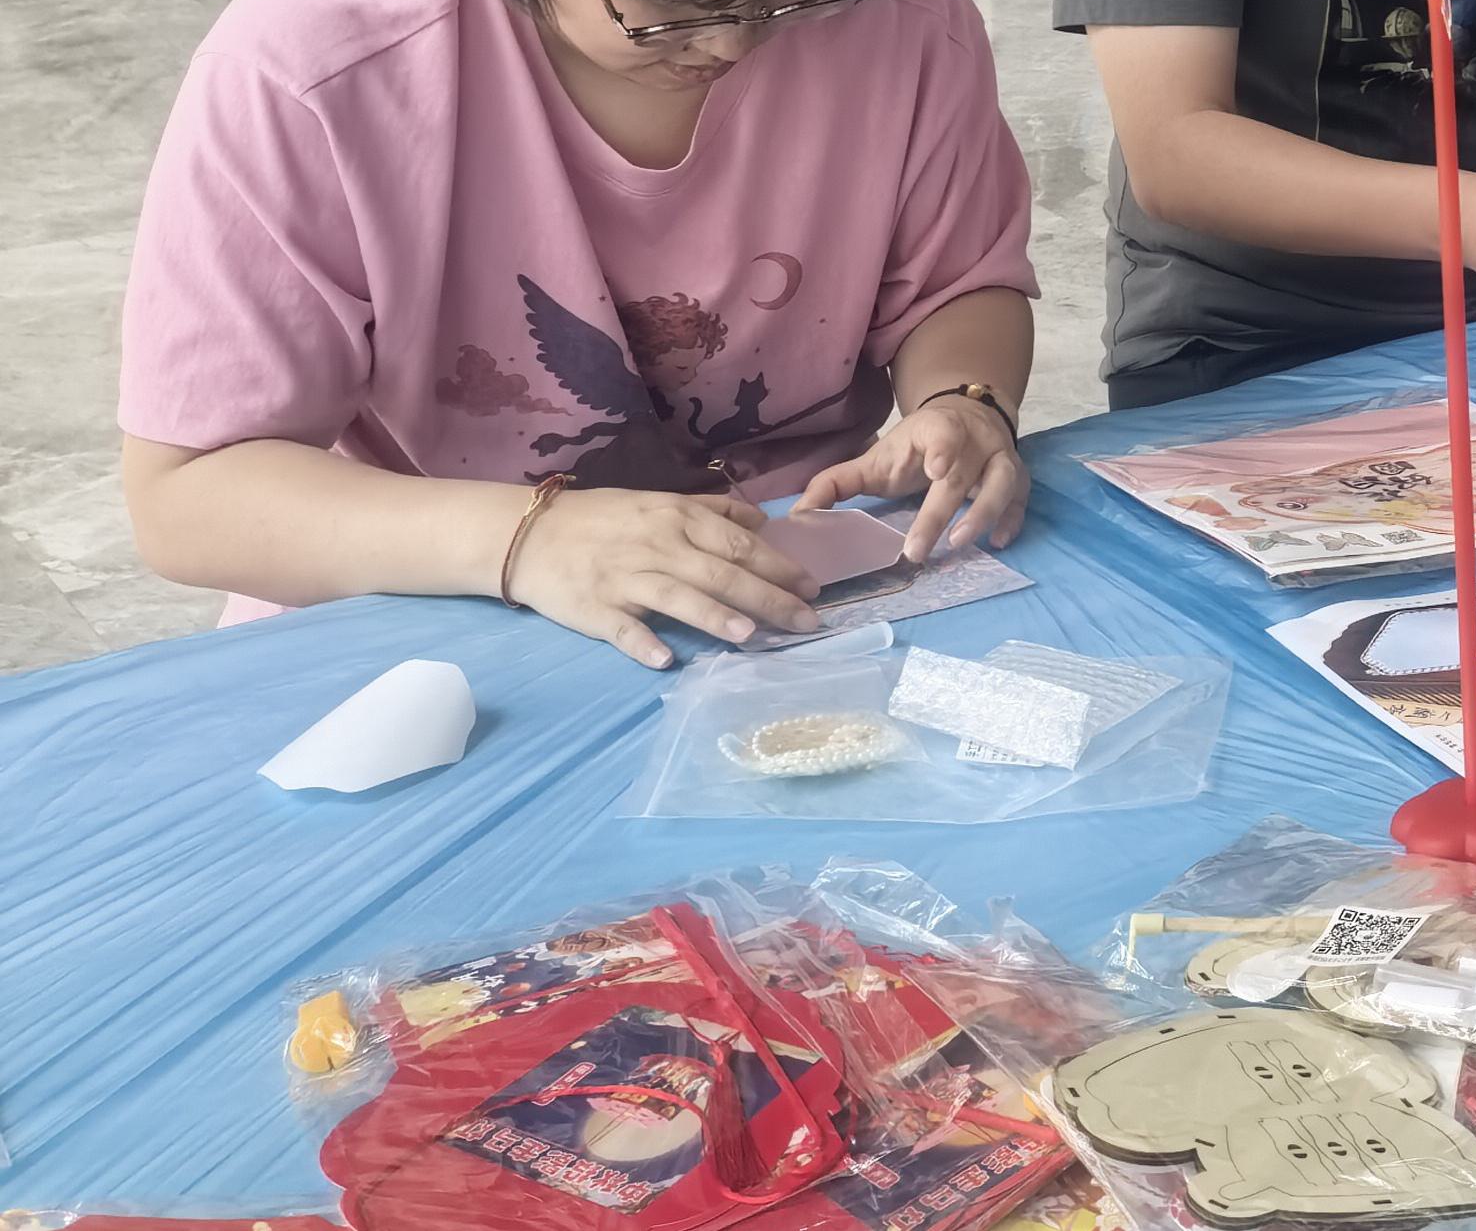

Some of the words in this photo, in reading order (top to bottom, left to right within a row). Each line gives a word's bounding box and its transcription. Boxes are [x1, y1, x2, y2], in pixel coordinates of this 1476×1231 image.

[453, 1118, 653, 1205] 中秋投影走马灯
